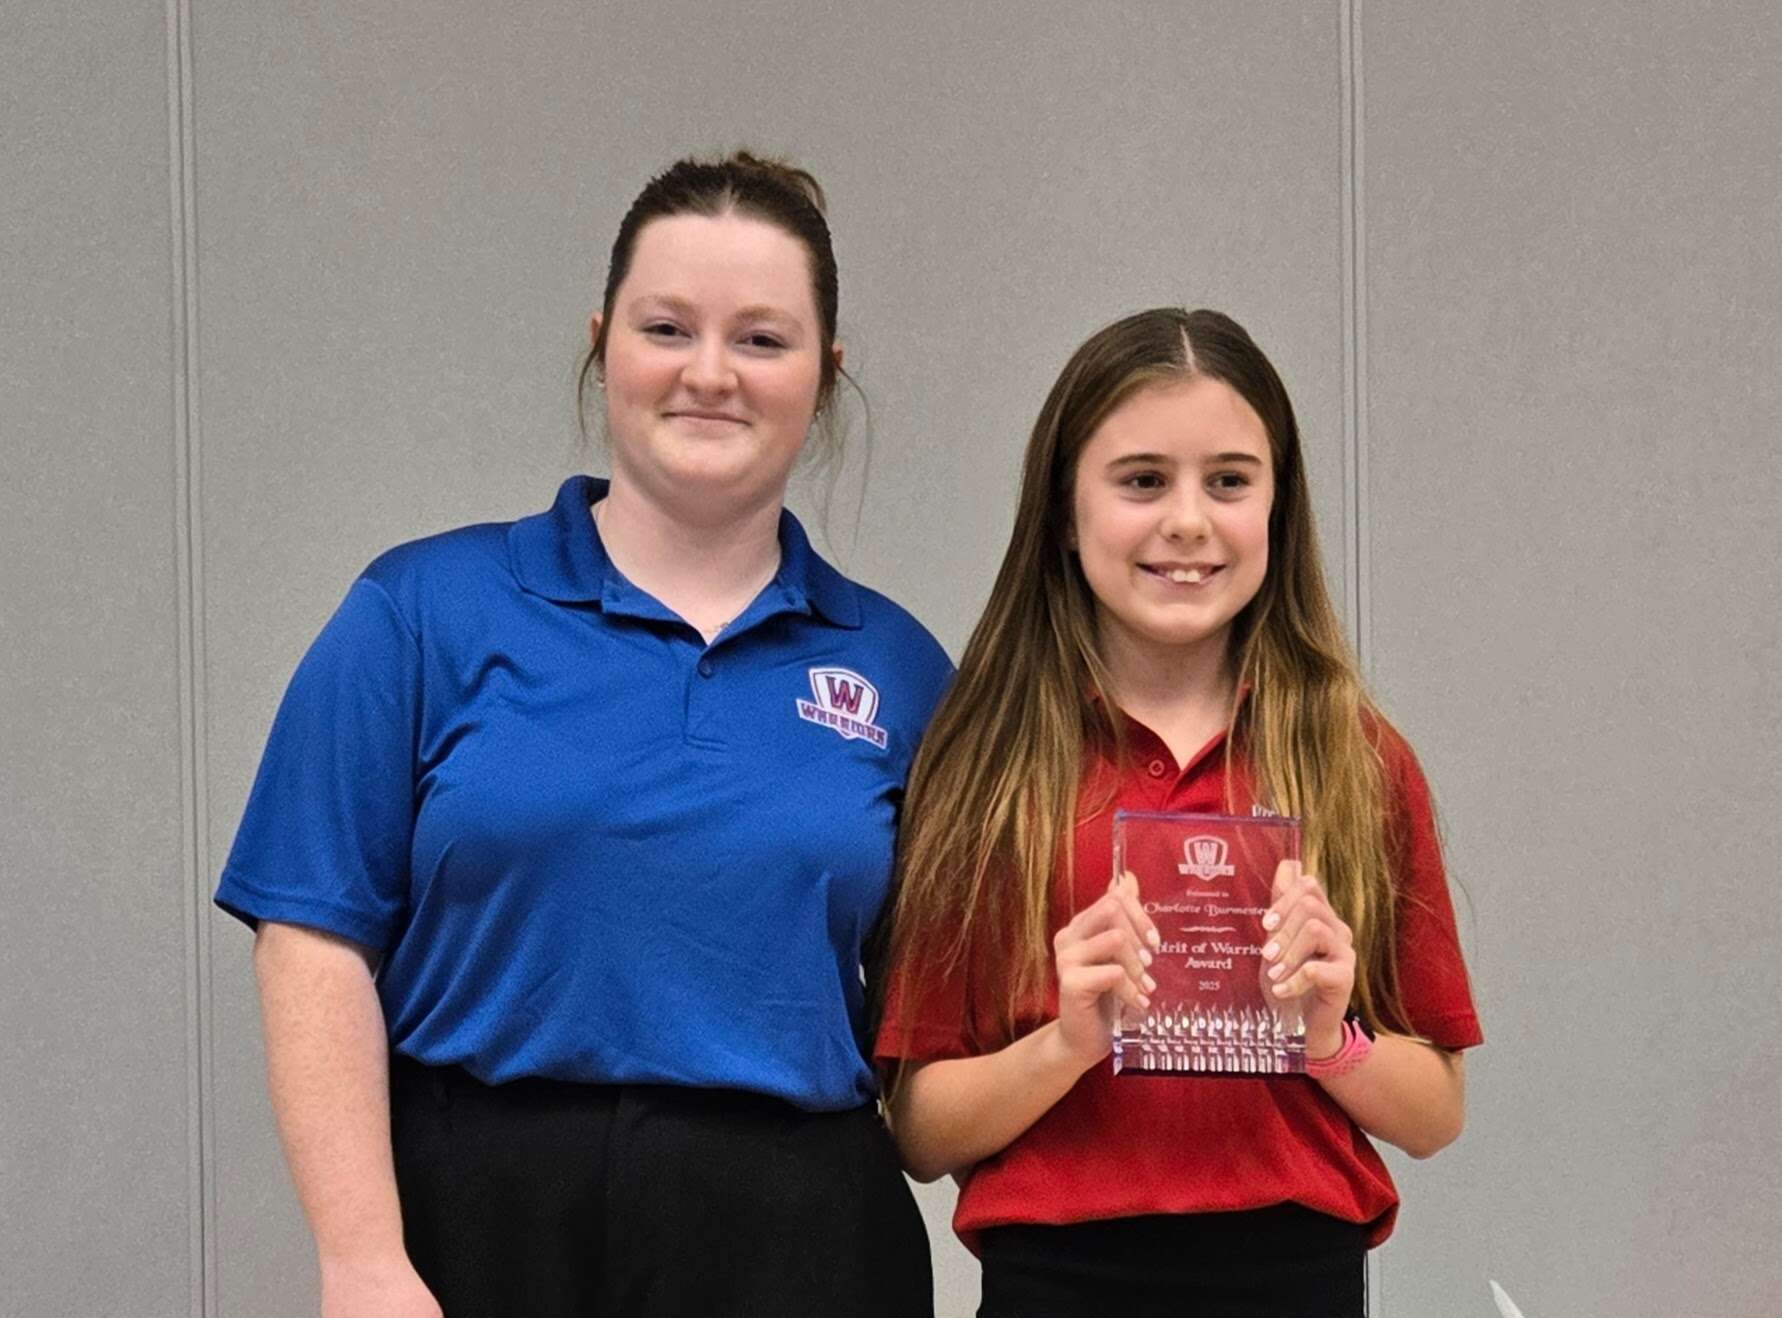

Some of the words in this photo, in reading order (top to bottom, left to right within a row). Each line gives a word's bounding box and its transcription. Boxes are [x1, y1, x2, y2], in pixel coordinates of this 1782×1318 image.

[825, 675, 864, 715] W
[1155, 941, 1189, 955] pirit
[1190, 941, 1208, 954] of
[1210, 942, 1264, 955] Warrio
[1183, 956, 1233, 970] Award
[1198, 980, 1221, 991] 2025
